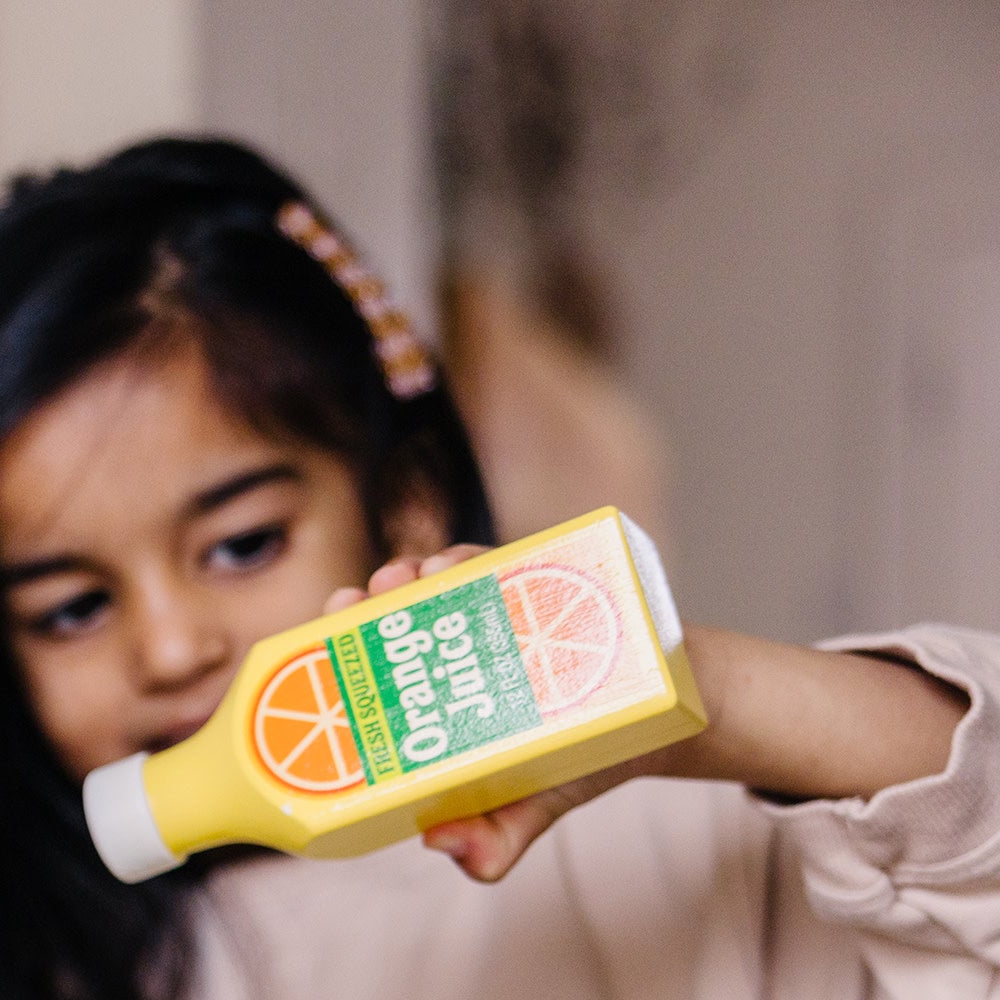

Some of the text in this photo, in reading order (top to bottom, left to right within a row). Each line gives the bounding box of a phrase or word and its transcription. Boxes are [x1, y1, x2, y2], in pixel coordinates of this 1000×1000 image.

[338, 634, 394, 775] FRESH SQUEEZED
[377, 610, 448, 762] Orange
[432, 611, 494, 719] Juice
